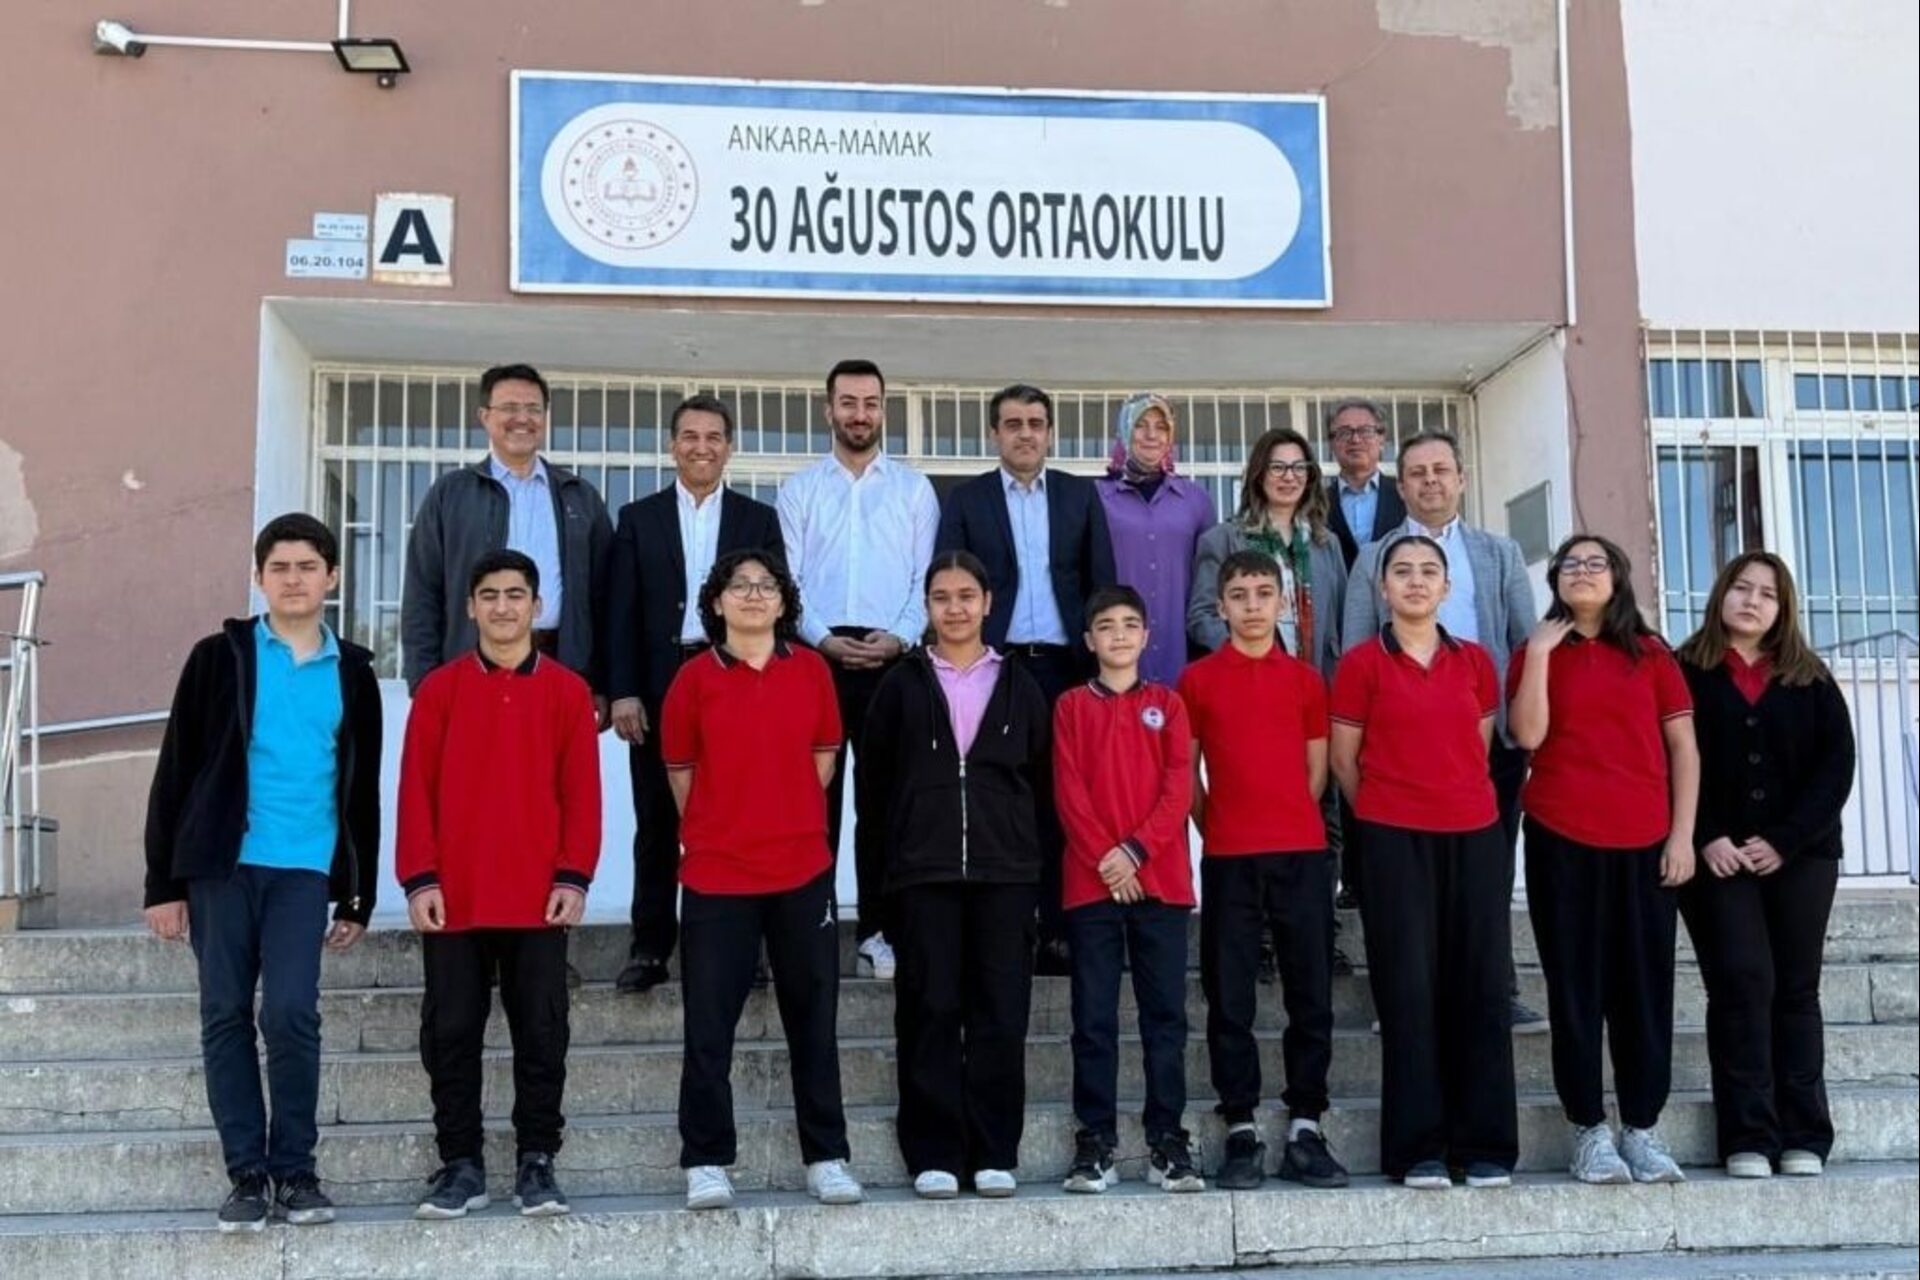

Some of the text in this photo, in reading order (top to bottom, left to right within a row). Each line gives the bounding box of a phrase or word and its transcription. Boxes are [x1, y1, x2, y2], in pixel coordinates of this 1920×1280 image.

[728, 124, 933, 157] ANKARA-MAMAK
[379, 208, 444, 265] A
[730, 171, 1225, 262] 30 AĞUSTOS ORTAOKULU
[289, 254, 364, 269] 06.20.104
